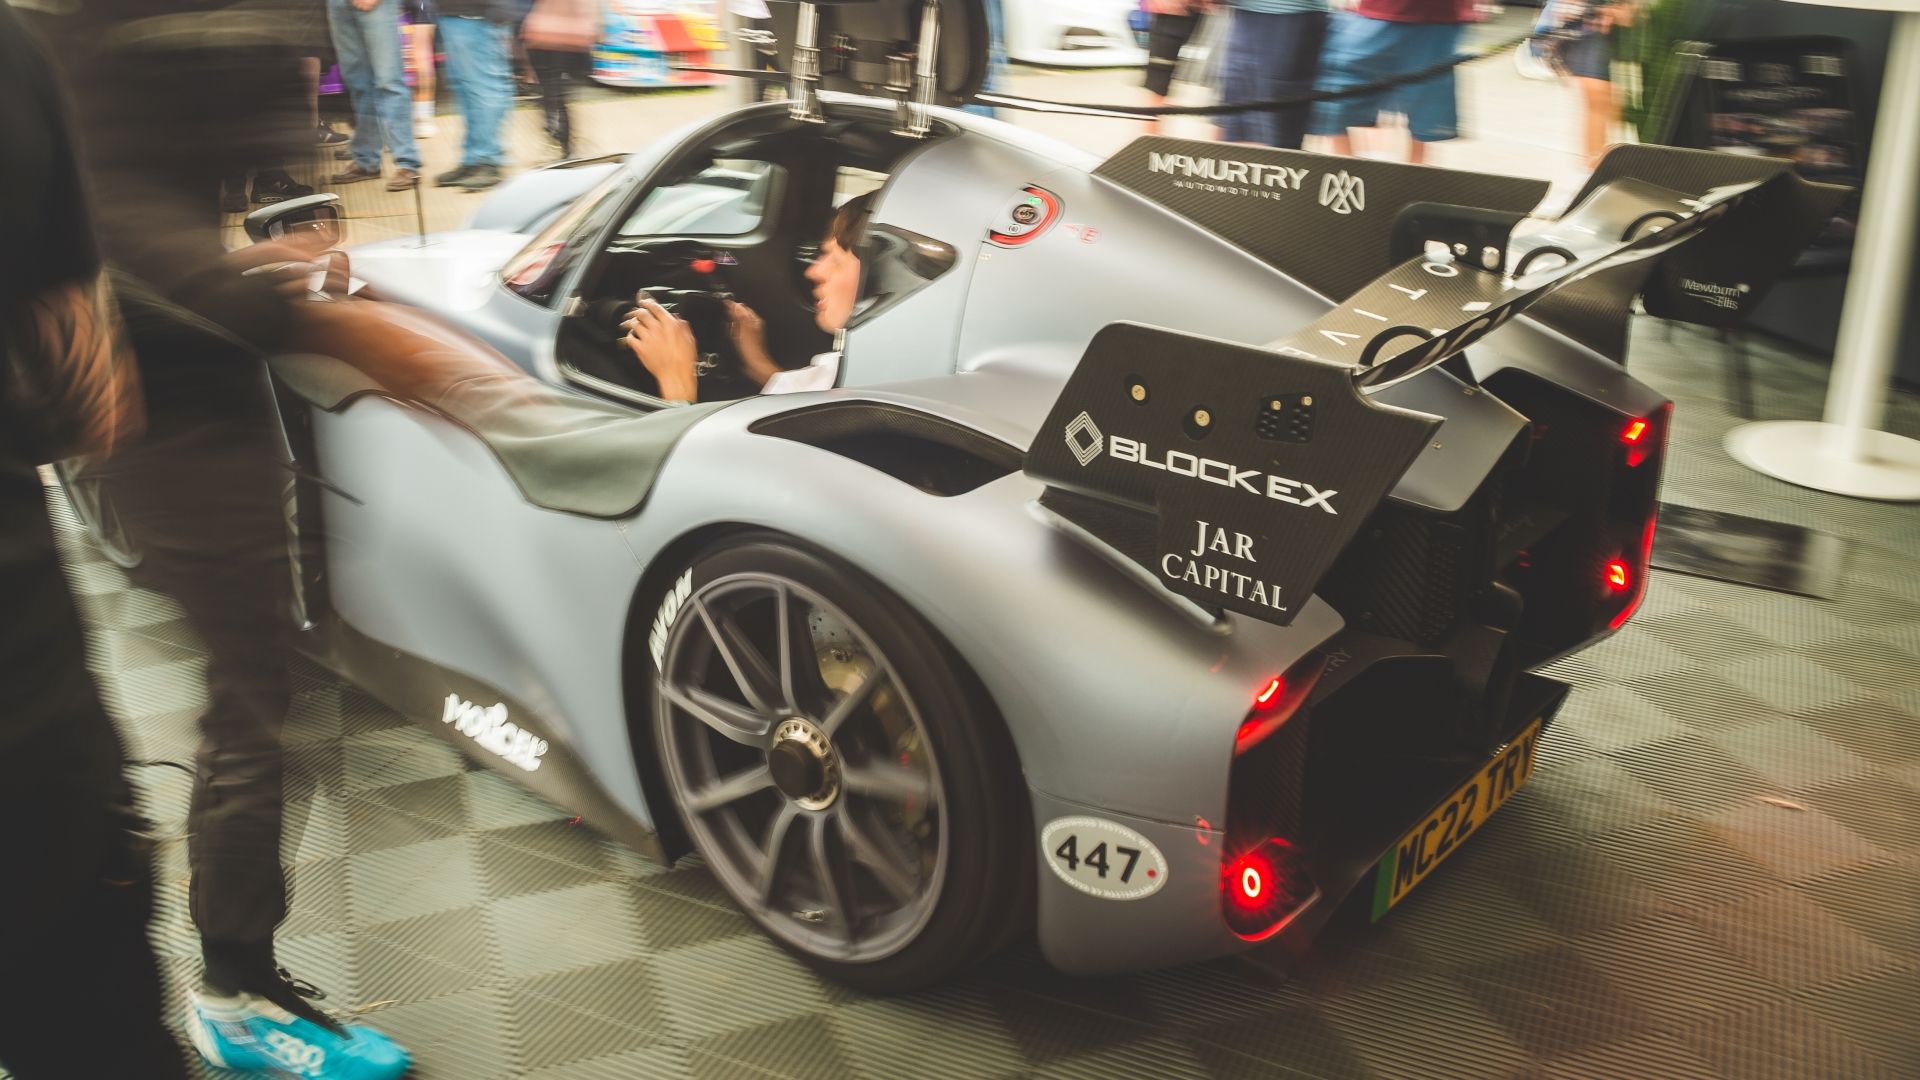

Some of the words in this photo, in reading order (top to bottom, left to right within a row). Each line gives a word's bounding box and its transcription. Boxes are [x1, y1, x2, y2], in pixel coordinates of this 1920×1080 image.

[1190, 520, 1257, 562] JAR
[1161, 553, 1288, 611] CAPITAL
[1056, 834, 1142, 884] 447
[1394, 784, 1478, 899] MC22
